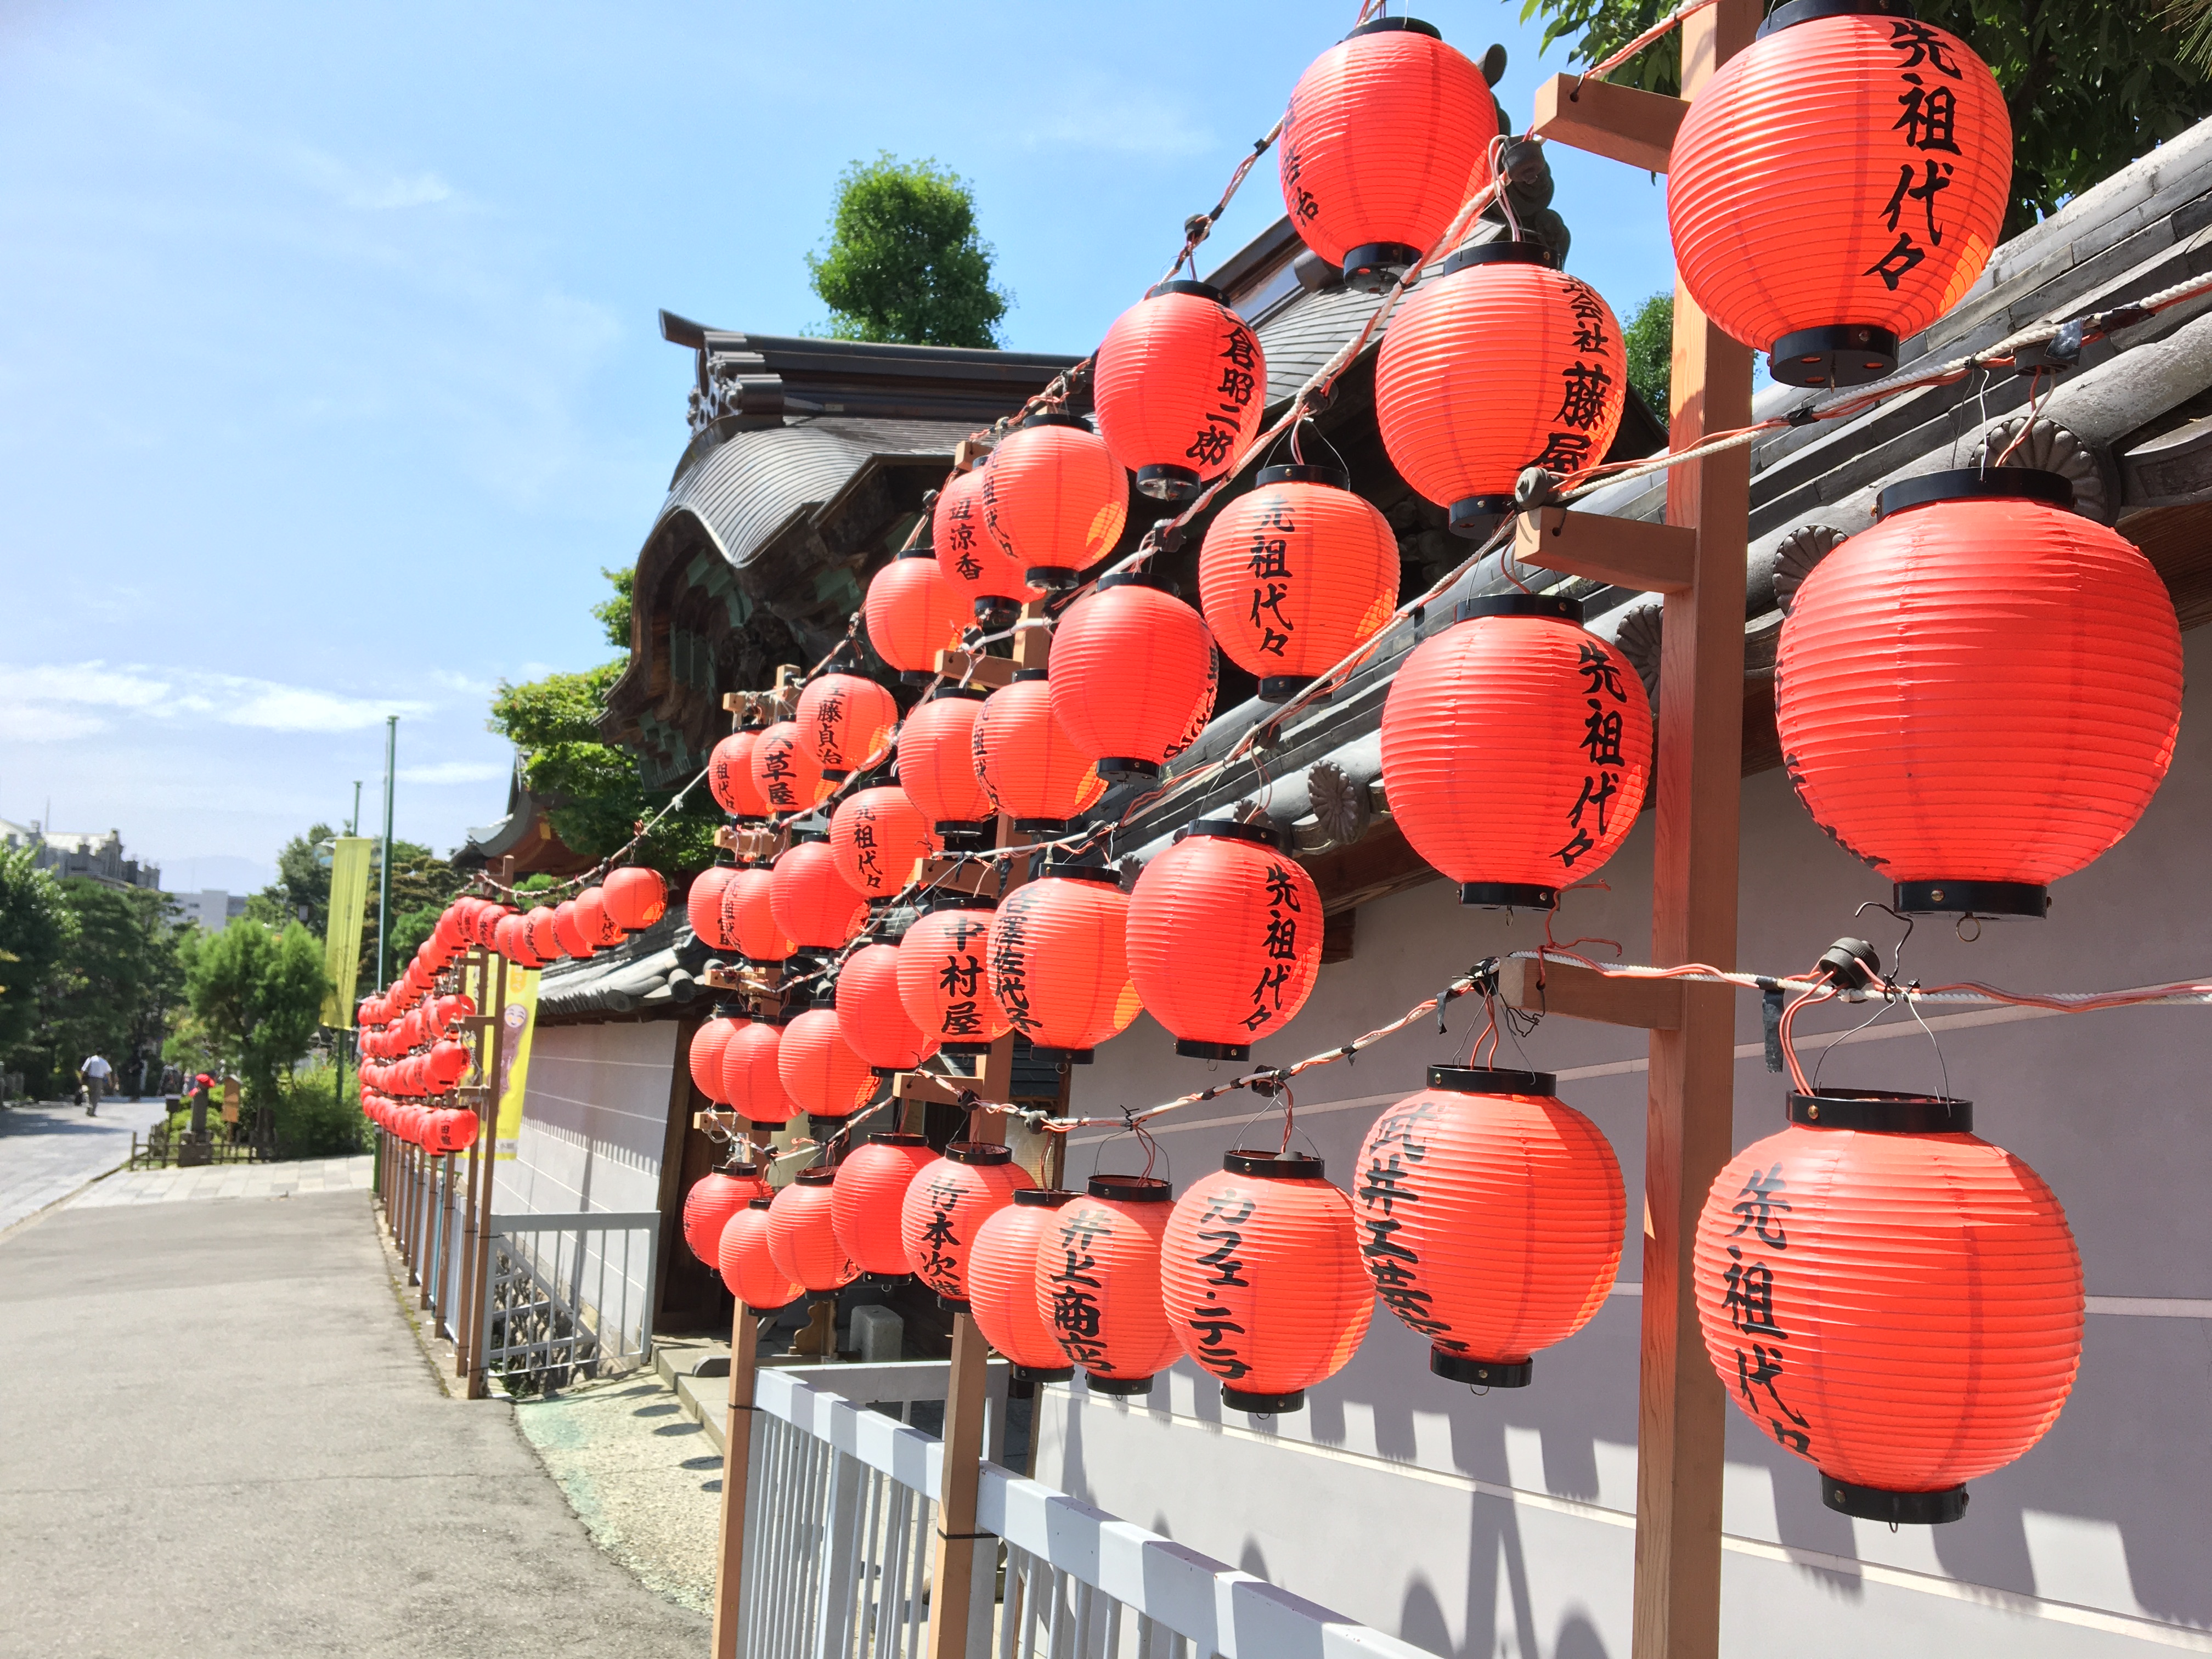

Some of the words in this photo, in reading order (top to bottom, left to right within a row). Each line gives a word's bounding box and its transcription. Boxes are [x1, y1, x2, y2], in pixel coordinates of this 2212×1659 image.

[1863, 20, 1963, 291] 先祖代々
[1517, 269, 1612, 473] 式会社藤屋
[949, 485, 984, 581] 辺涼香
[1247, 494, 1296, 658] 先祖代々
[1549, 639, 1628, 868] 先祖代々
[854, 803, 884, 890] 先祖代々
[940, 916, 986, 1036] 中村屋
[1238, 863, 1302, 1031] 先祖代々
[1049, 1209, 1117, 1373] 井上商店
[1188, 1188, 1256, 1380] カフェ・テラ
[1721, 1161, 1821, 1463] 先祖代々
